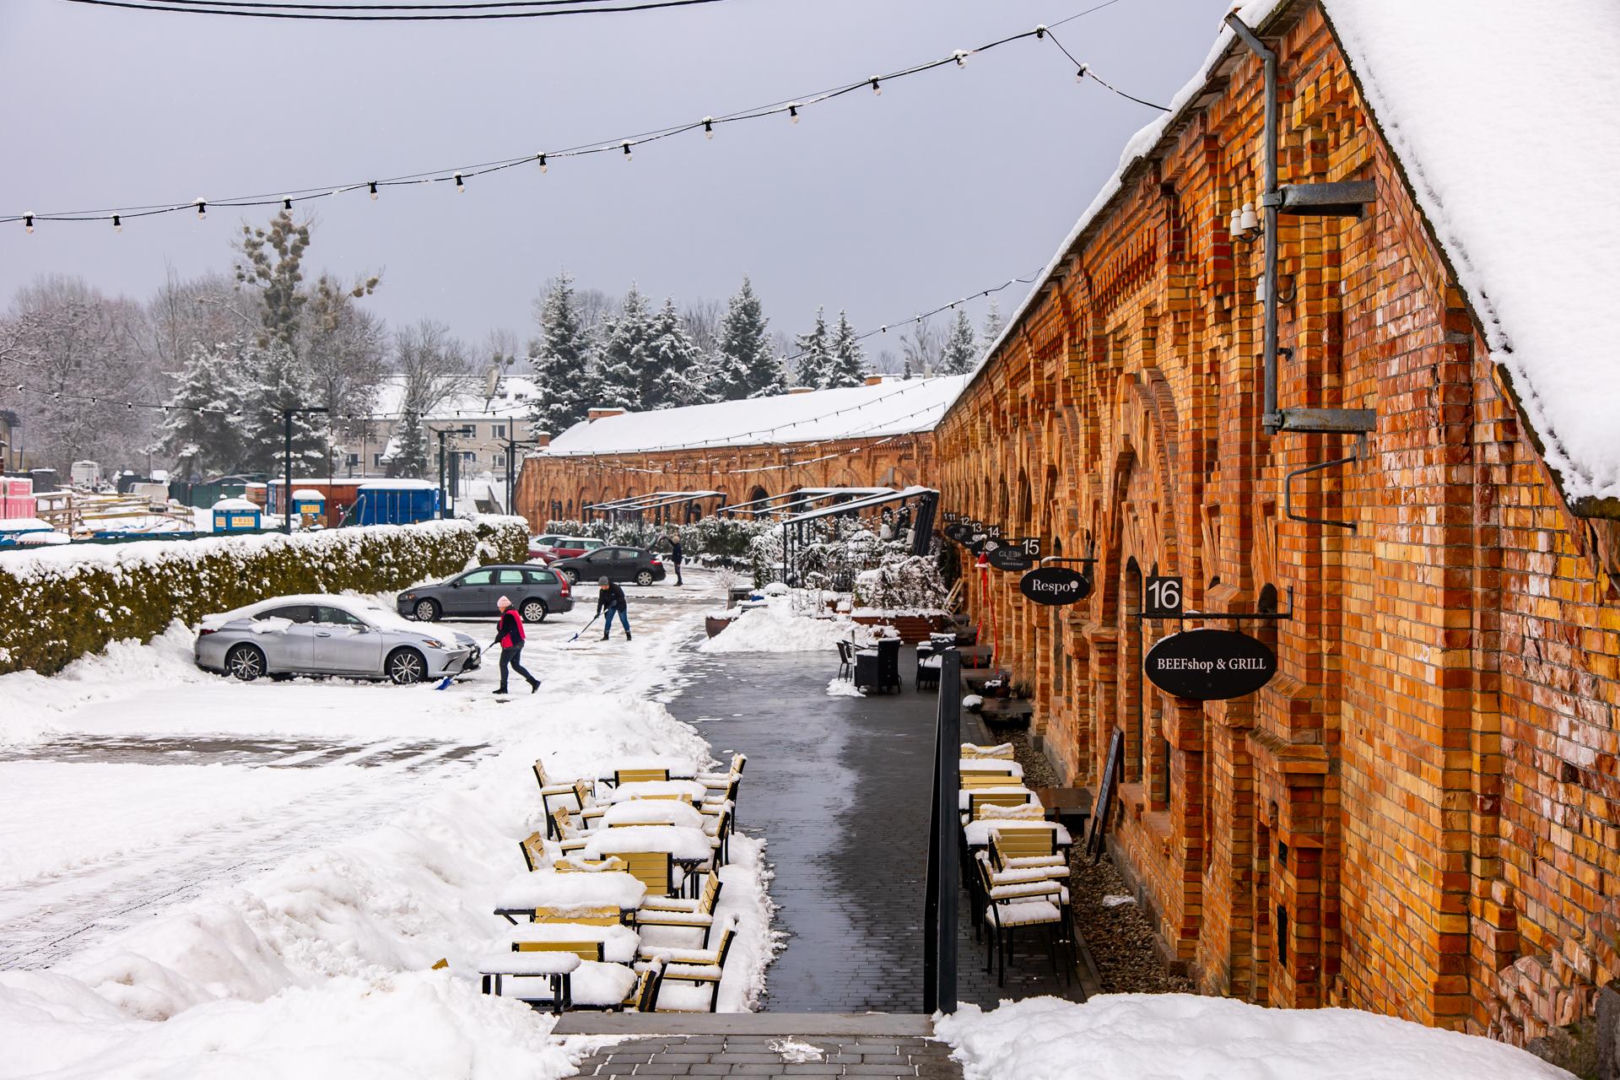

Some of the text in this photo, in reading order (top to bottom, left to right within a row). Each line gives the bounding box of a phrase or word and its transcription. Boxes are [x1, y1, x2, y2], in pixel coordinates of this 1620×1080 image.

[961, 517, 970, 526] 12
[972, 523, 983, 533] 13
[987, 526, 1000, 538] 14
[1022, 539, 1040, 555] 15
[1148, 580, 1180, 609] 16
[1157, 657, 1266, 674] BEEFshop & GRILL
